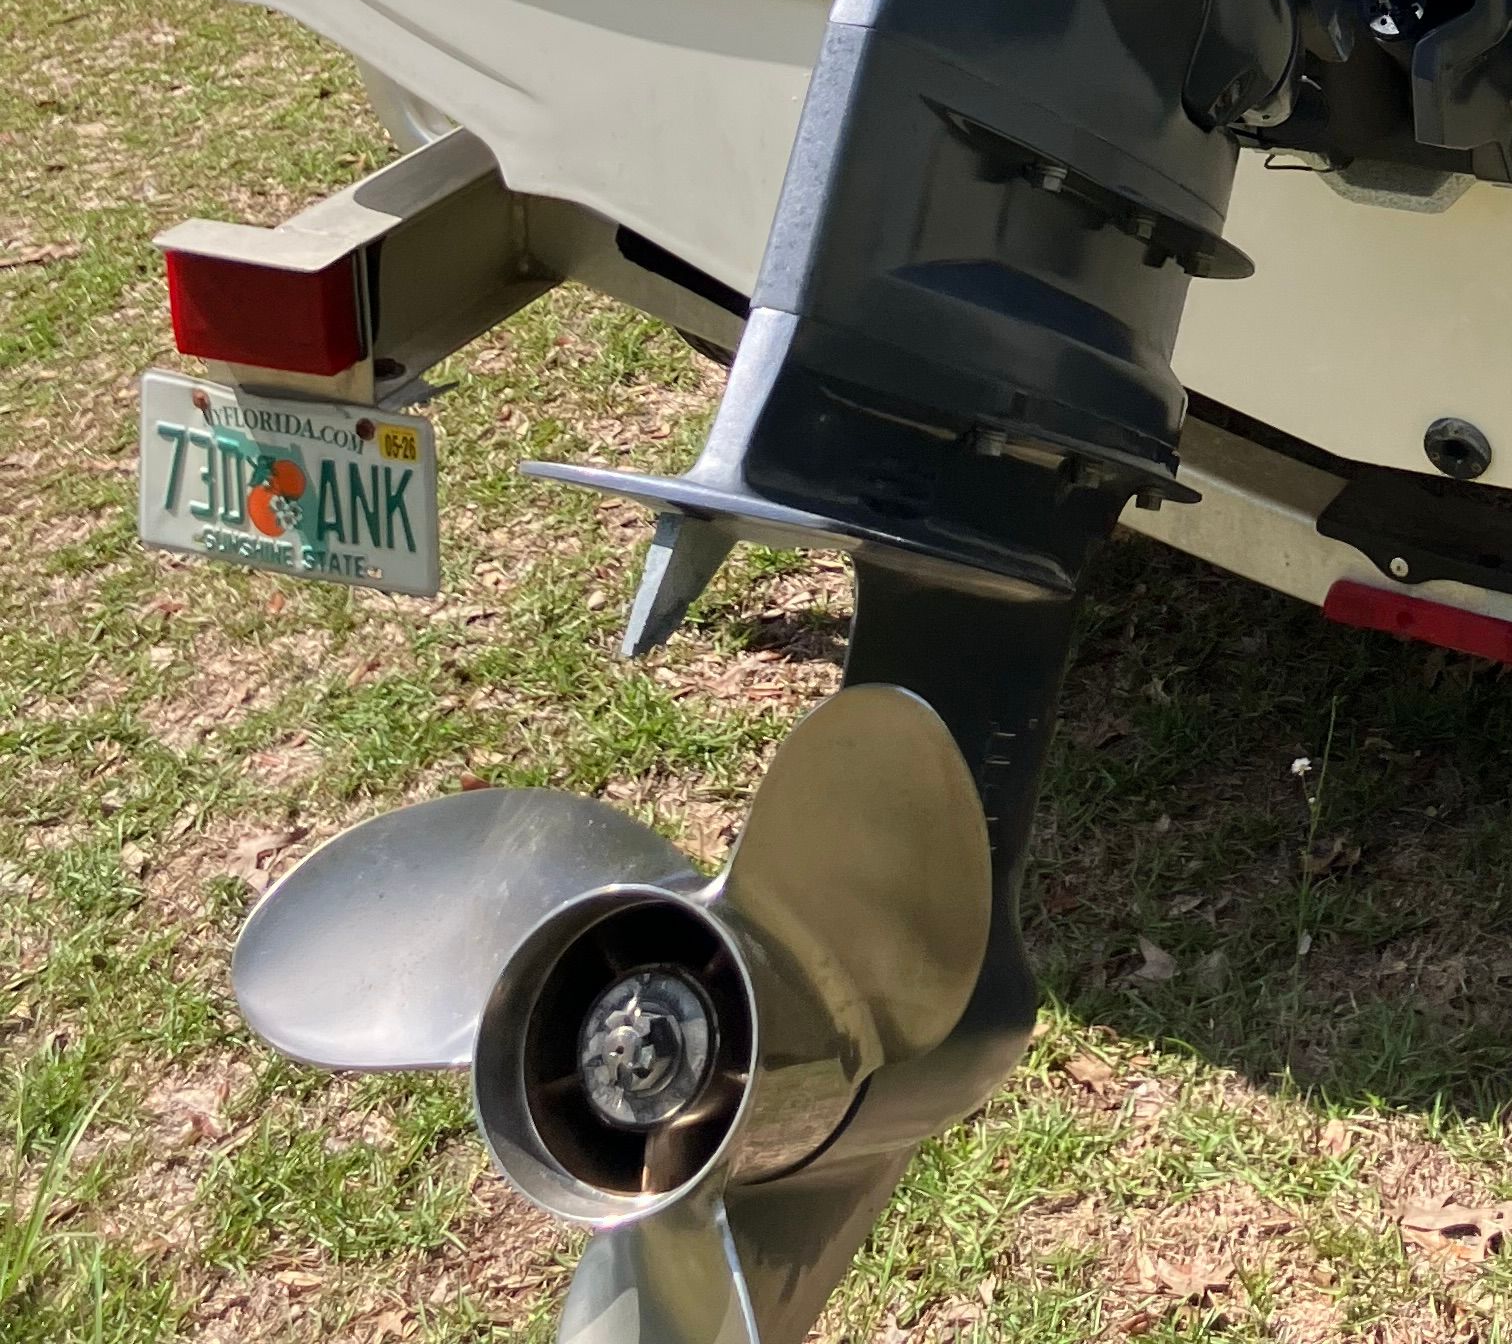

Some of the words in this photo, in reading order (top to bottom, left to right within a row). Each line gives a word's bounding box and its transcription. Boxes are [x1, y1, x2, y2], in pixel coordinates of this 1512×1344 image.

[384, 433, 416, 460] 05-26
[317, 459, 416, 553] ANK
[203, 525, 293, 567] SUNSHINE
[301, 545, 366, 579] STATE
